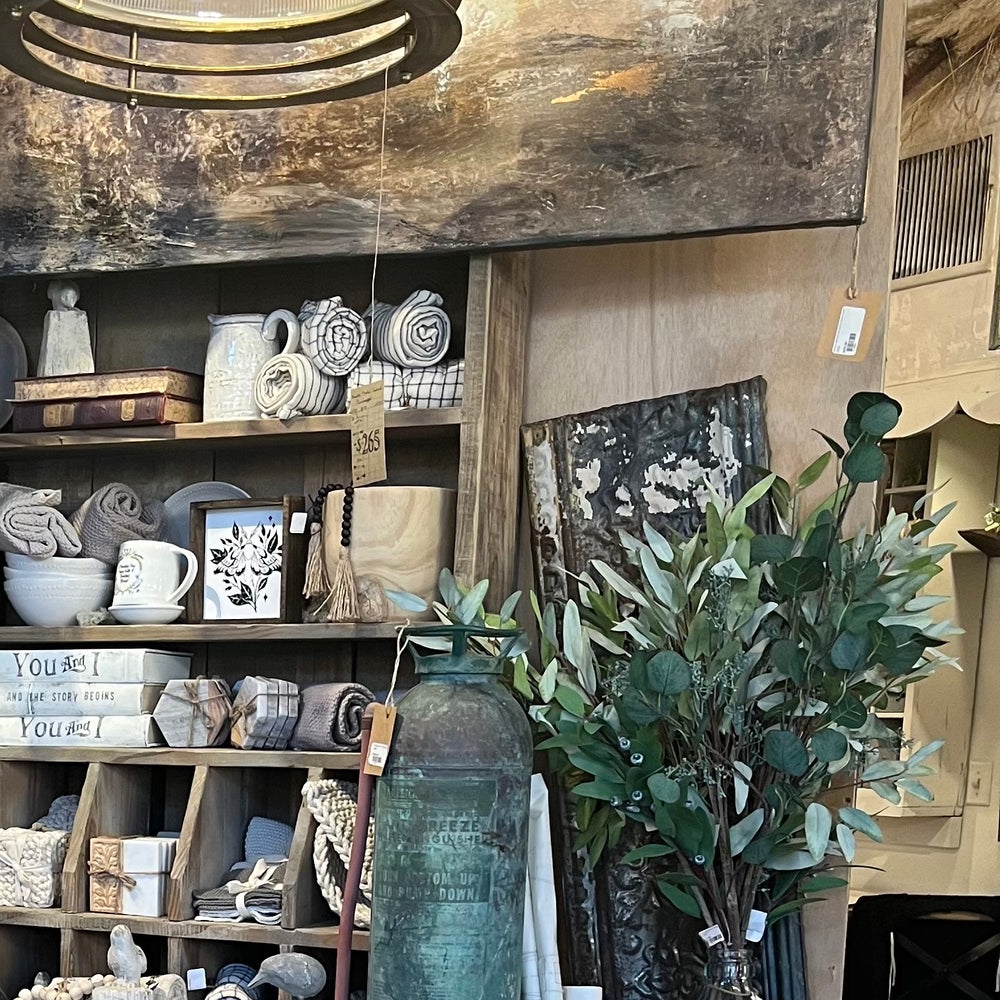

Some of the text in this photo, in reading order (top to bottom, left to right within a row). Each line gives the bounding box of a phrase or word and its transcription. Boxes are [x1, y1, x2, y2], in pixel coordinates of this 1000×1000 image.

[61, 654, 87, 673] And
[92, 652, 101, 677] I
[6, 691, 23, 702] AND
[51, 691, 78, 703] STORY
[84, 690, 116, 702] BEGINS
[65, 720, 91, 737] And
